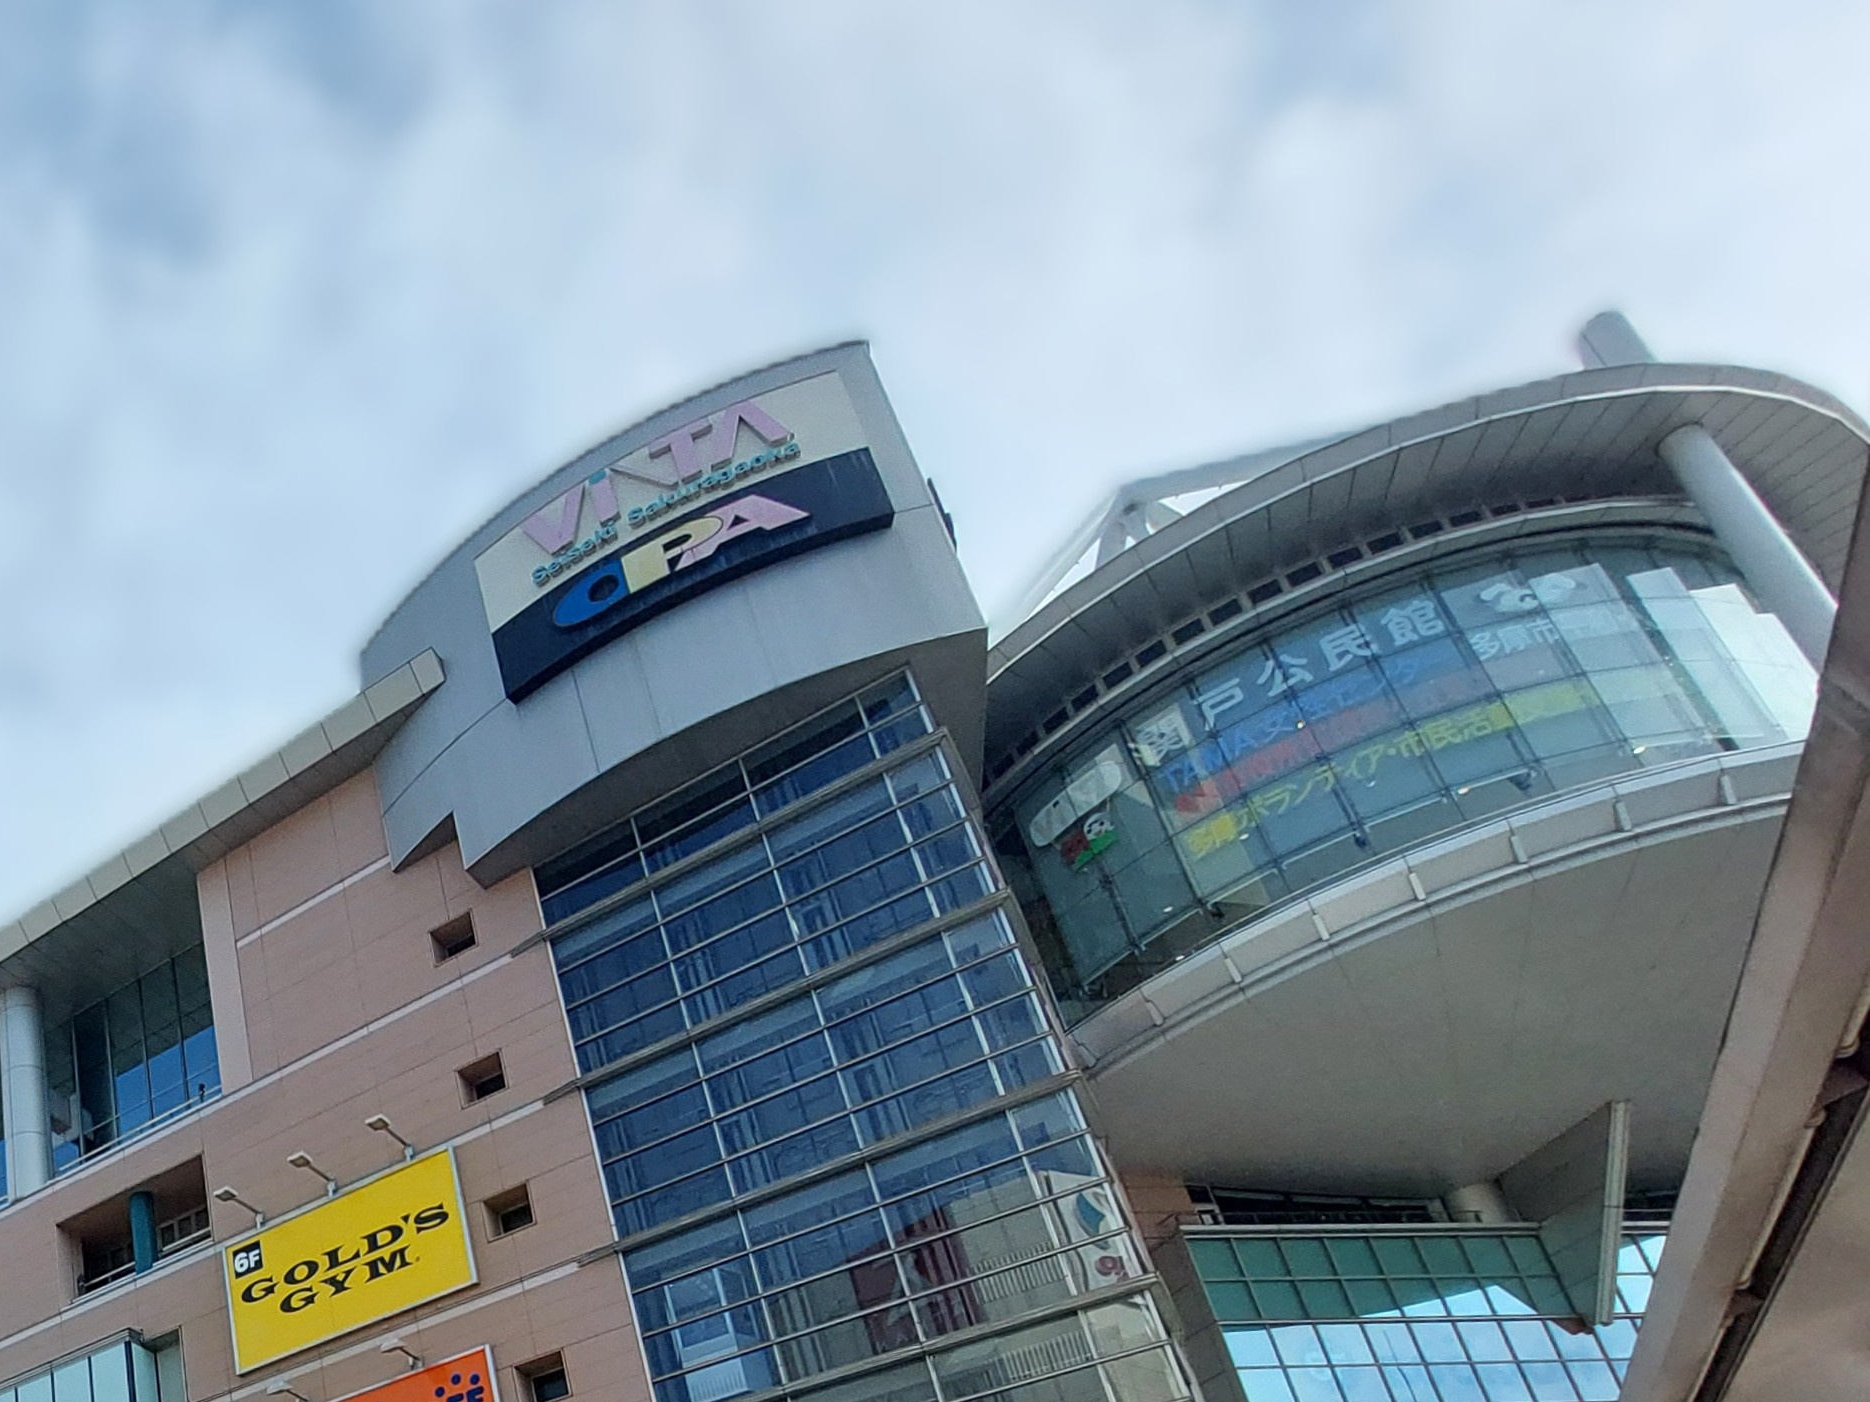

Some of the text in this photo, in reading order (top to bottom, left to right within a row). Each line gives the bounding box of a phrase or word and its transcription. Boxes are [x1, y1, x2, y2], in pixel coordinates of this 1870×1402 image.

[532, 439, 801, 586] Seiseki Sakuragaoka
[553, 493, 811, 628] OPA
[1133, 599, 1446, 769] 関戸公民館
[234, 1246, 261, 1274] 6F
[241, 1203, 450, 1304] GOLD'S
[279, 1244, 412, 1313] GYM
